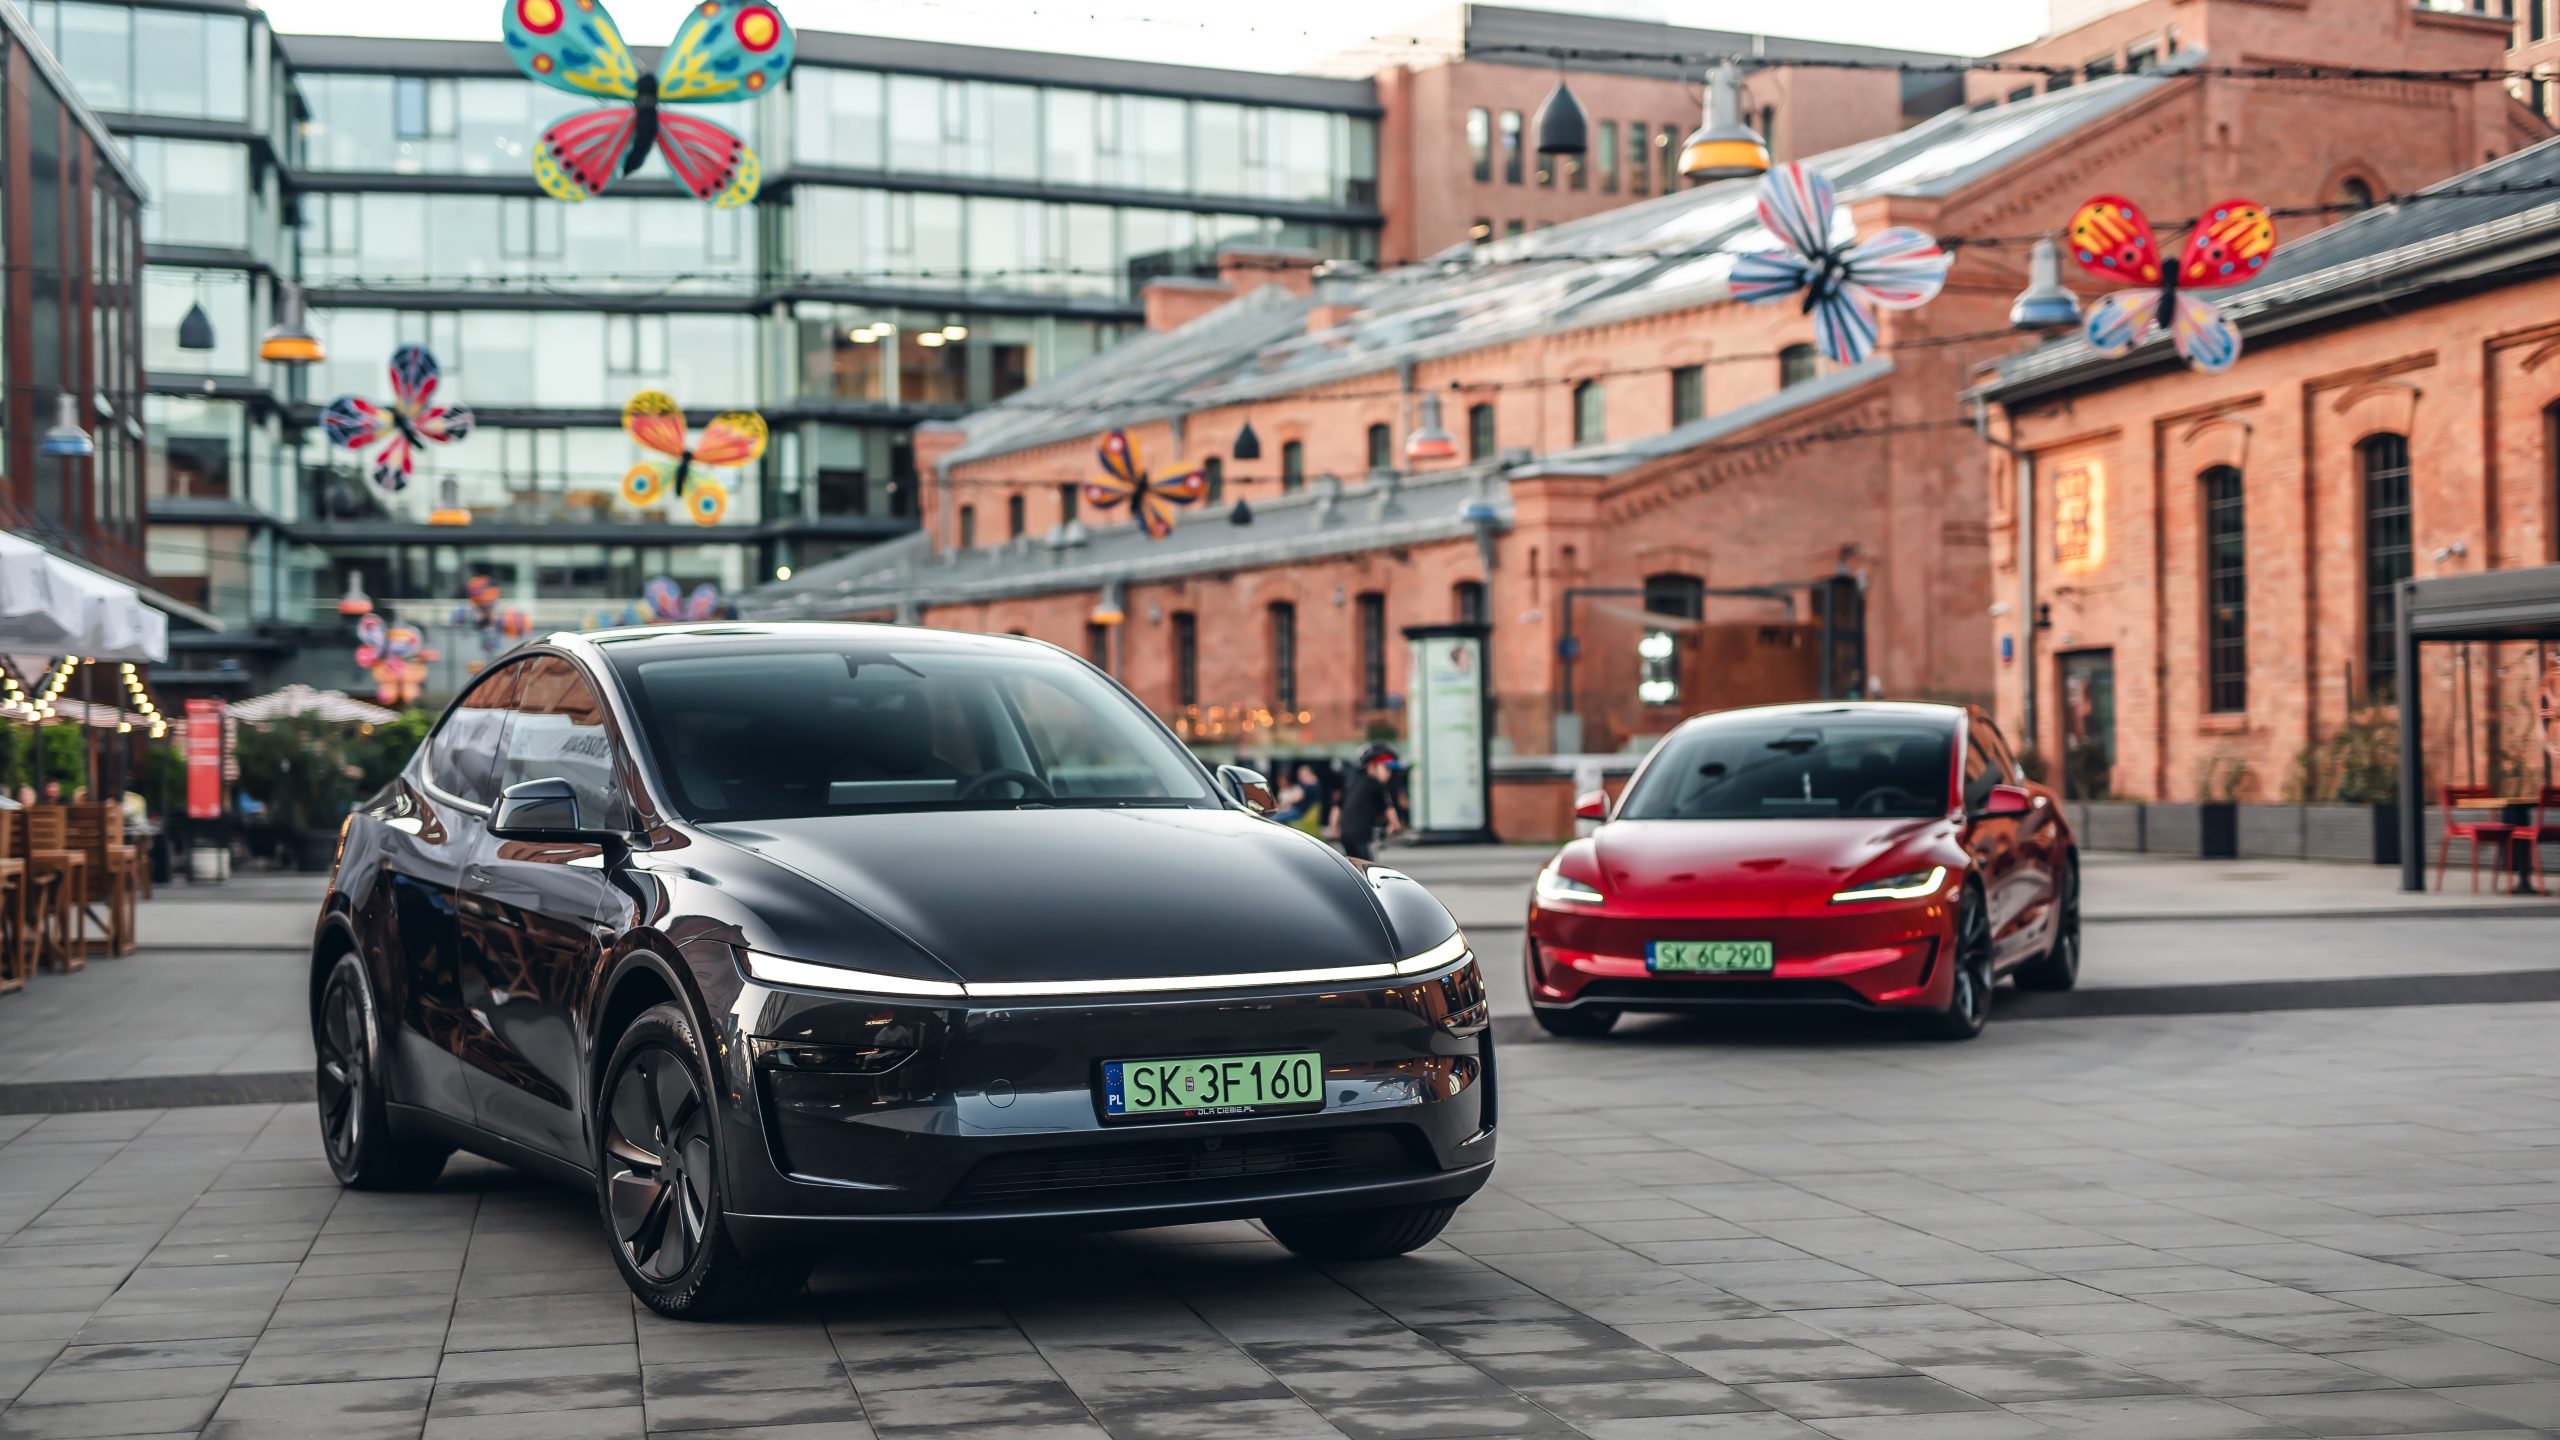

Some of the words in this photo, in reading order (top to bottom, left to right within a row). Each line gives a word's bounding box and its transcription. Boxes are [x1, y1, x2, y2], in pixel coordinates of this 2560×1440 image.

[1661, 943, 1688, 969] SK
[1697, 943, 1766, 969] 6C290
[1133, 1065, 1183, 1107] SK
[1198, 1058, 1313, 1103] 3F160
[1108, 1093, 1123, 1106] PL
